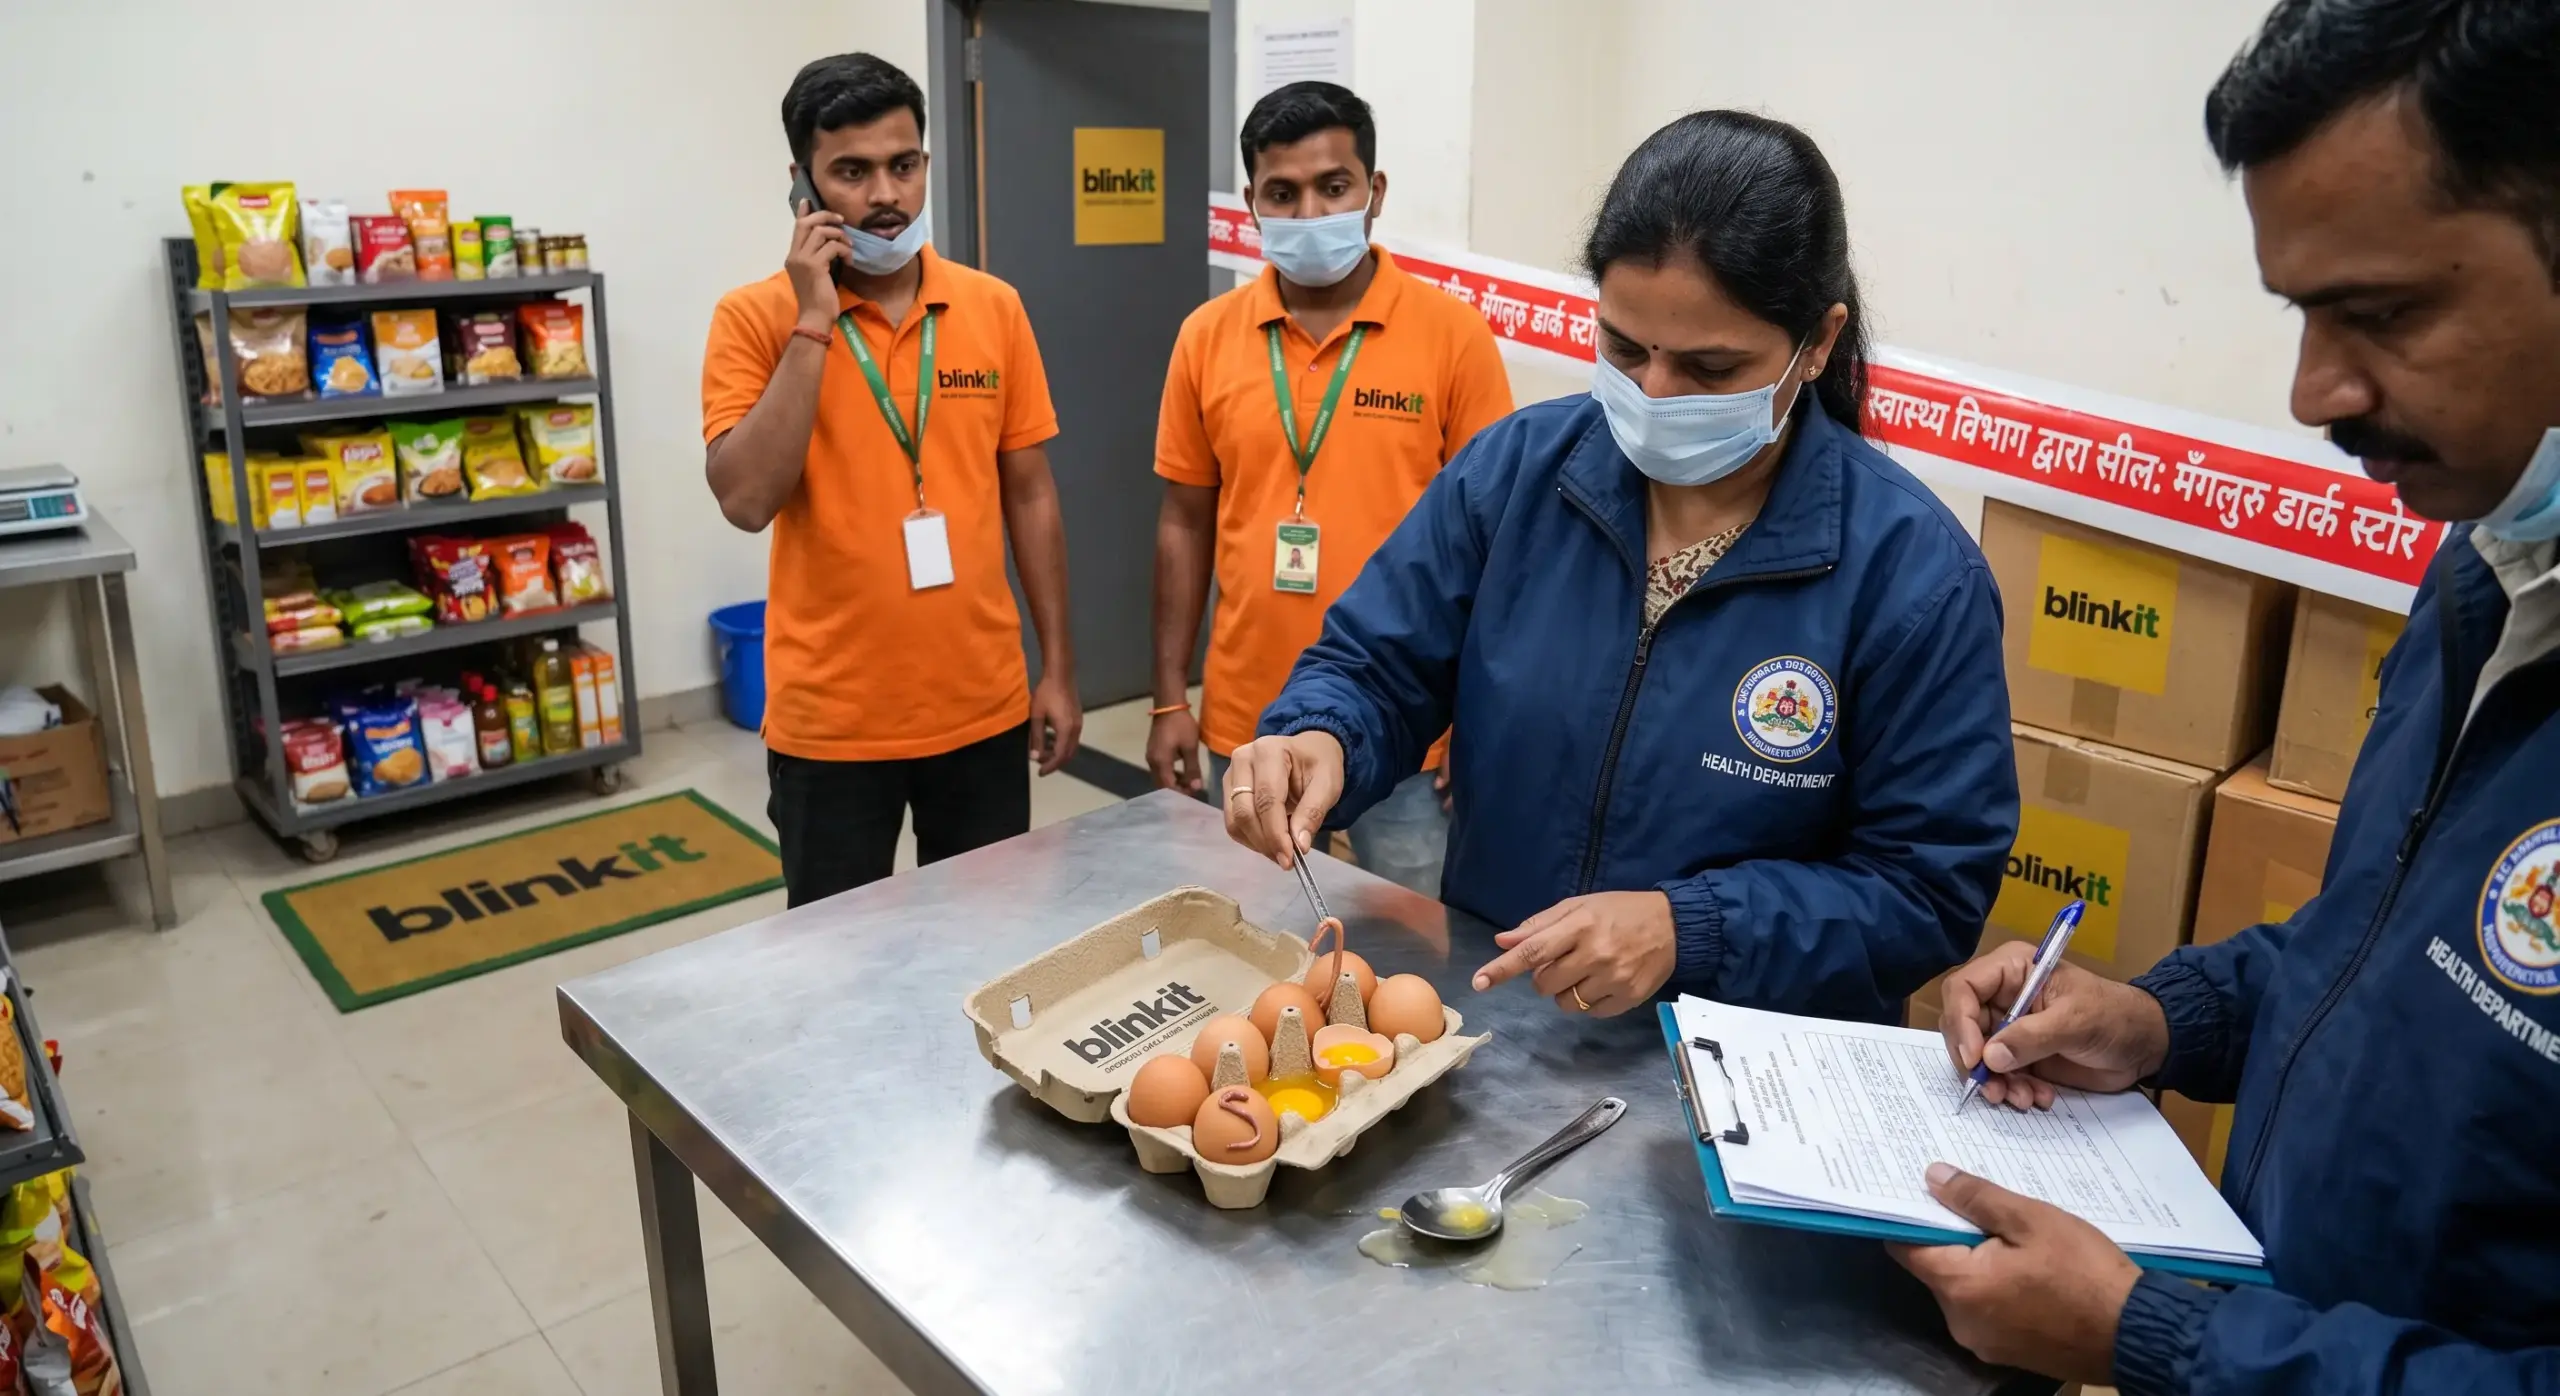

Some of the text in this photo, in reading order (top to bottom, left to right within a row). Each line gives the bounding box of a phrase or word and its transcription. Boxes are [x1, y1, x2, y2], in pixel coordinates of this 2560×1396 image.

[1083, 168, 1156, 193] blinkit
[1531, 300, 1566, 338] डार्क
[1568, 307, 1599, 348] स्टो
[938, 368, 1000, 390] blinkit
[1354, 387, 1424, 415] blinkit
[1869, 386, 1951, 437] स्वास्थ्य
[1952, 395, 2032, 458] विभाग
[2032, 426, 2093, 474] द्वारा
[2096, 432, 2166, 495] सील:
[2272, 483, 2345, 538] डार्क
[2350, 497, 2426, 561] स्टोर
[2044, 585, 2160, 639] blinkit
[1701, 752, 1835, 789] HEALTH DEPARTMENT
[366, 834, 707, 944] blinkit
[2425, 935, 2479, 995] HEALTH
[1063, 981, 1206, 1065] blinkit
